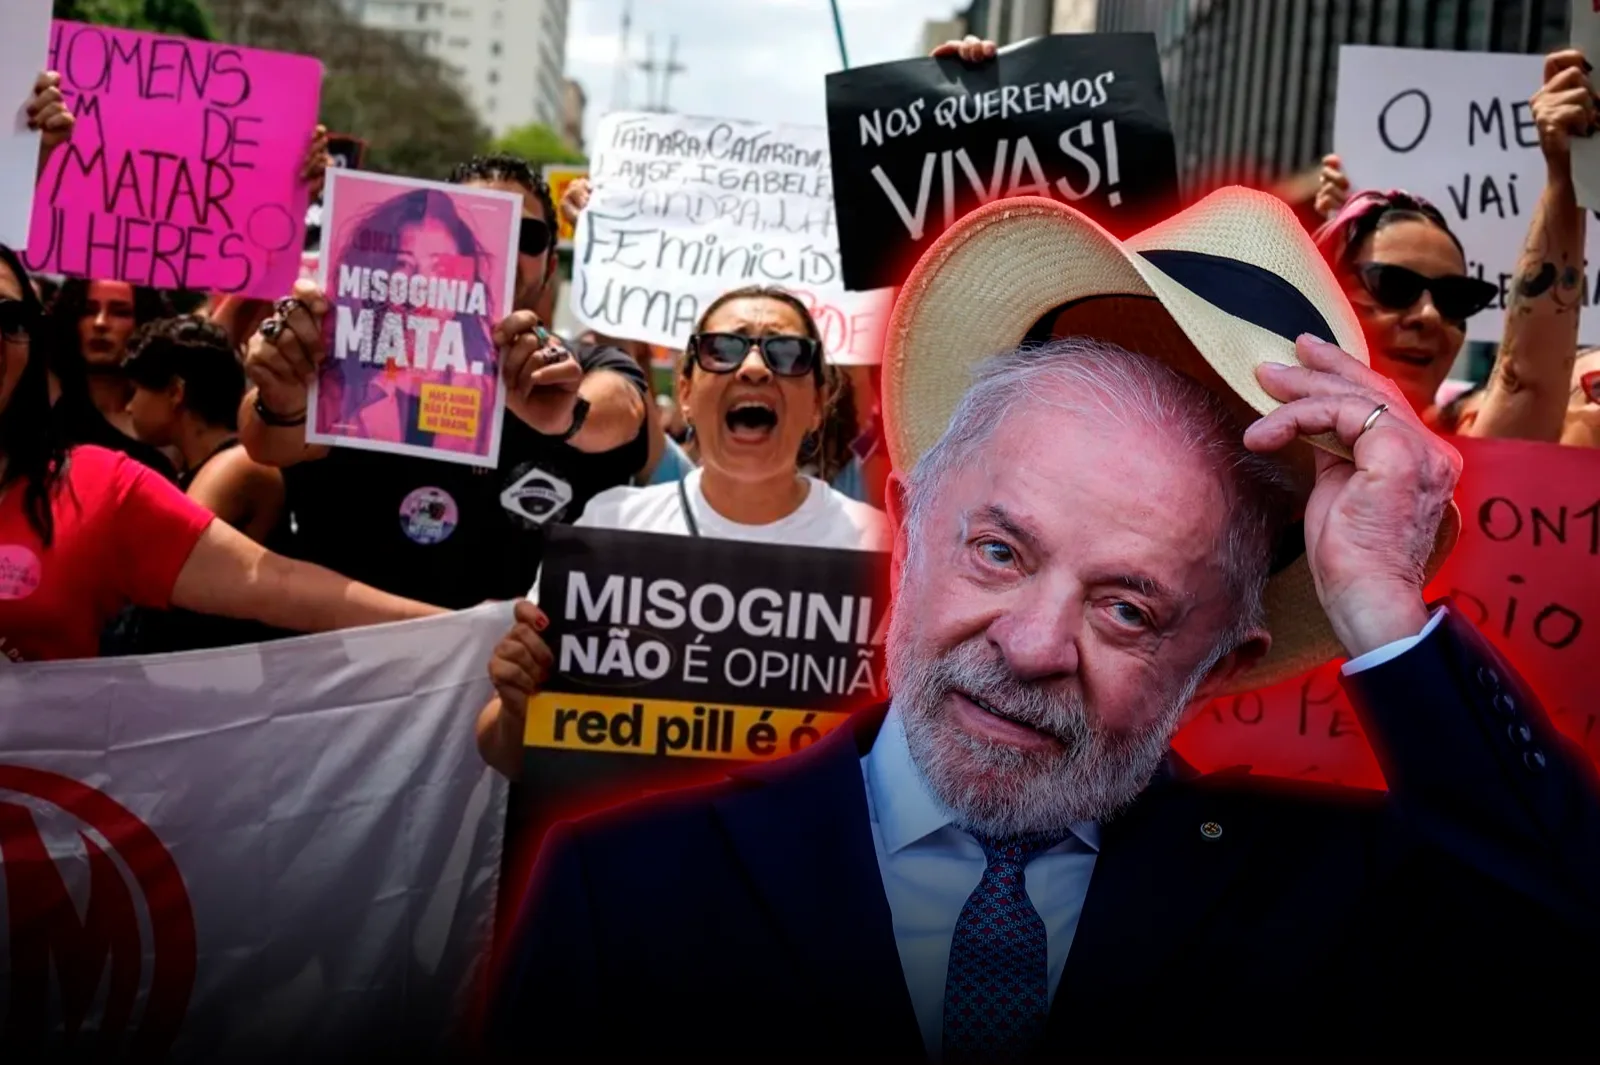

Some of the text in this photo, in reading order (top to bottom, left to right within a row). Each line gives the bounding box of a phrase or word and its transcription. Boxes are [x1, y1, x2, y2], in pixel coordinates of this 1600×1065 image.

[200, 107, 264, 169] DE
[858, 70, 1115, 148] NOS QUEREMOS
[1377, 88, 1432, 153] O
[49, 142, 234, 230] MATAR
[870, 119, 1122, 241] VIVAS!
[337, 264, 487, 316] MISOGINIA
[333, 305, 485, 376] MATA.
[558, 627, 889, 698] NÃO É OPINIÃ
[552, 703, 834, 756] red pill é ó
